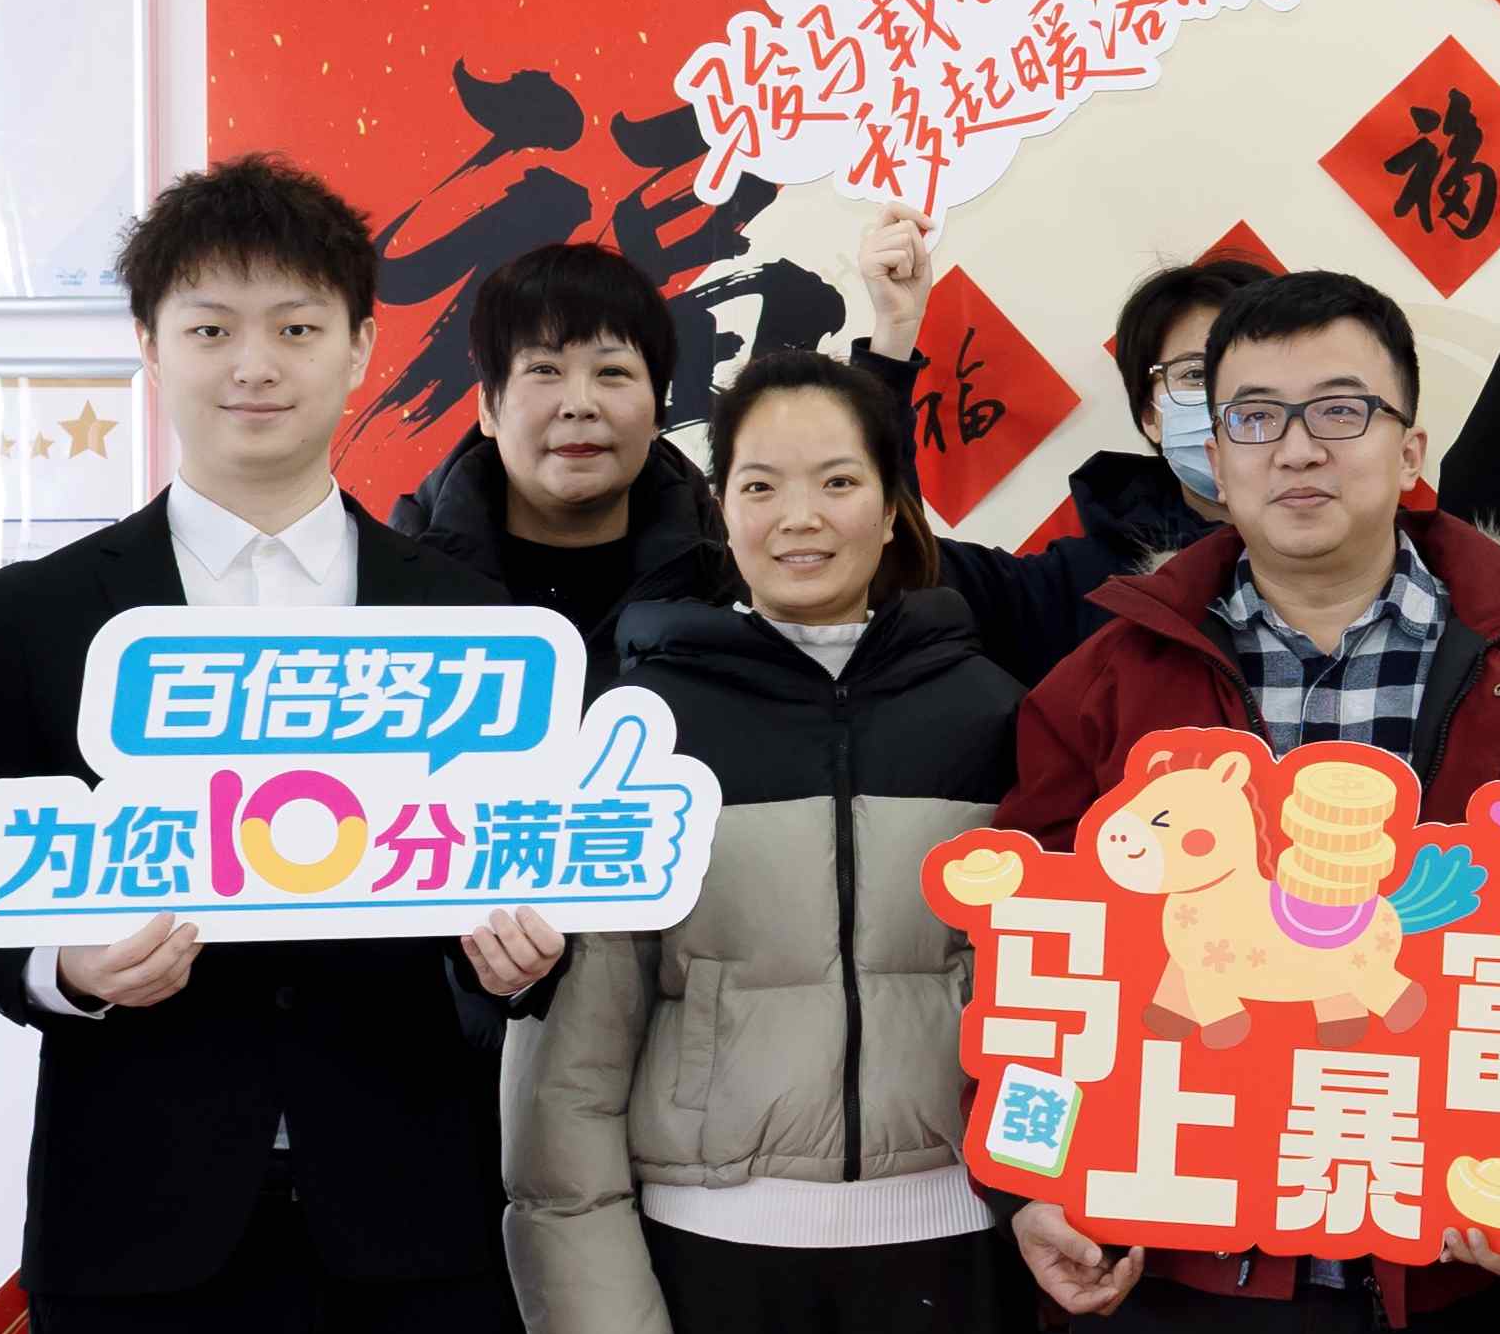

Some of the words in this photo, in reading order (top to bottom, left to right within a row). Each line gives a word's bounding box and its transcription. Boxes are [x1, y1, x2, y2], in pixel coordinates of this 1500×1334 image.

[1384, 85, 1499, 240] 福
[143, 648, 527, 742] 百倍努力
[1001, 1080, 1068, 1151] 發
